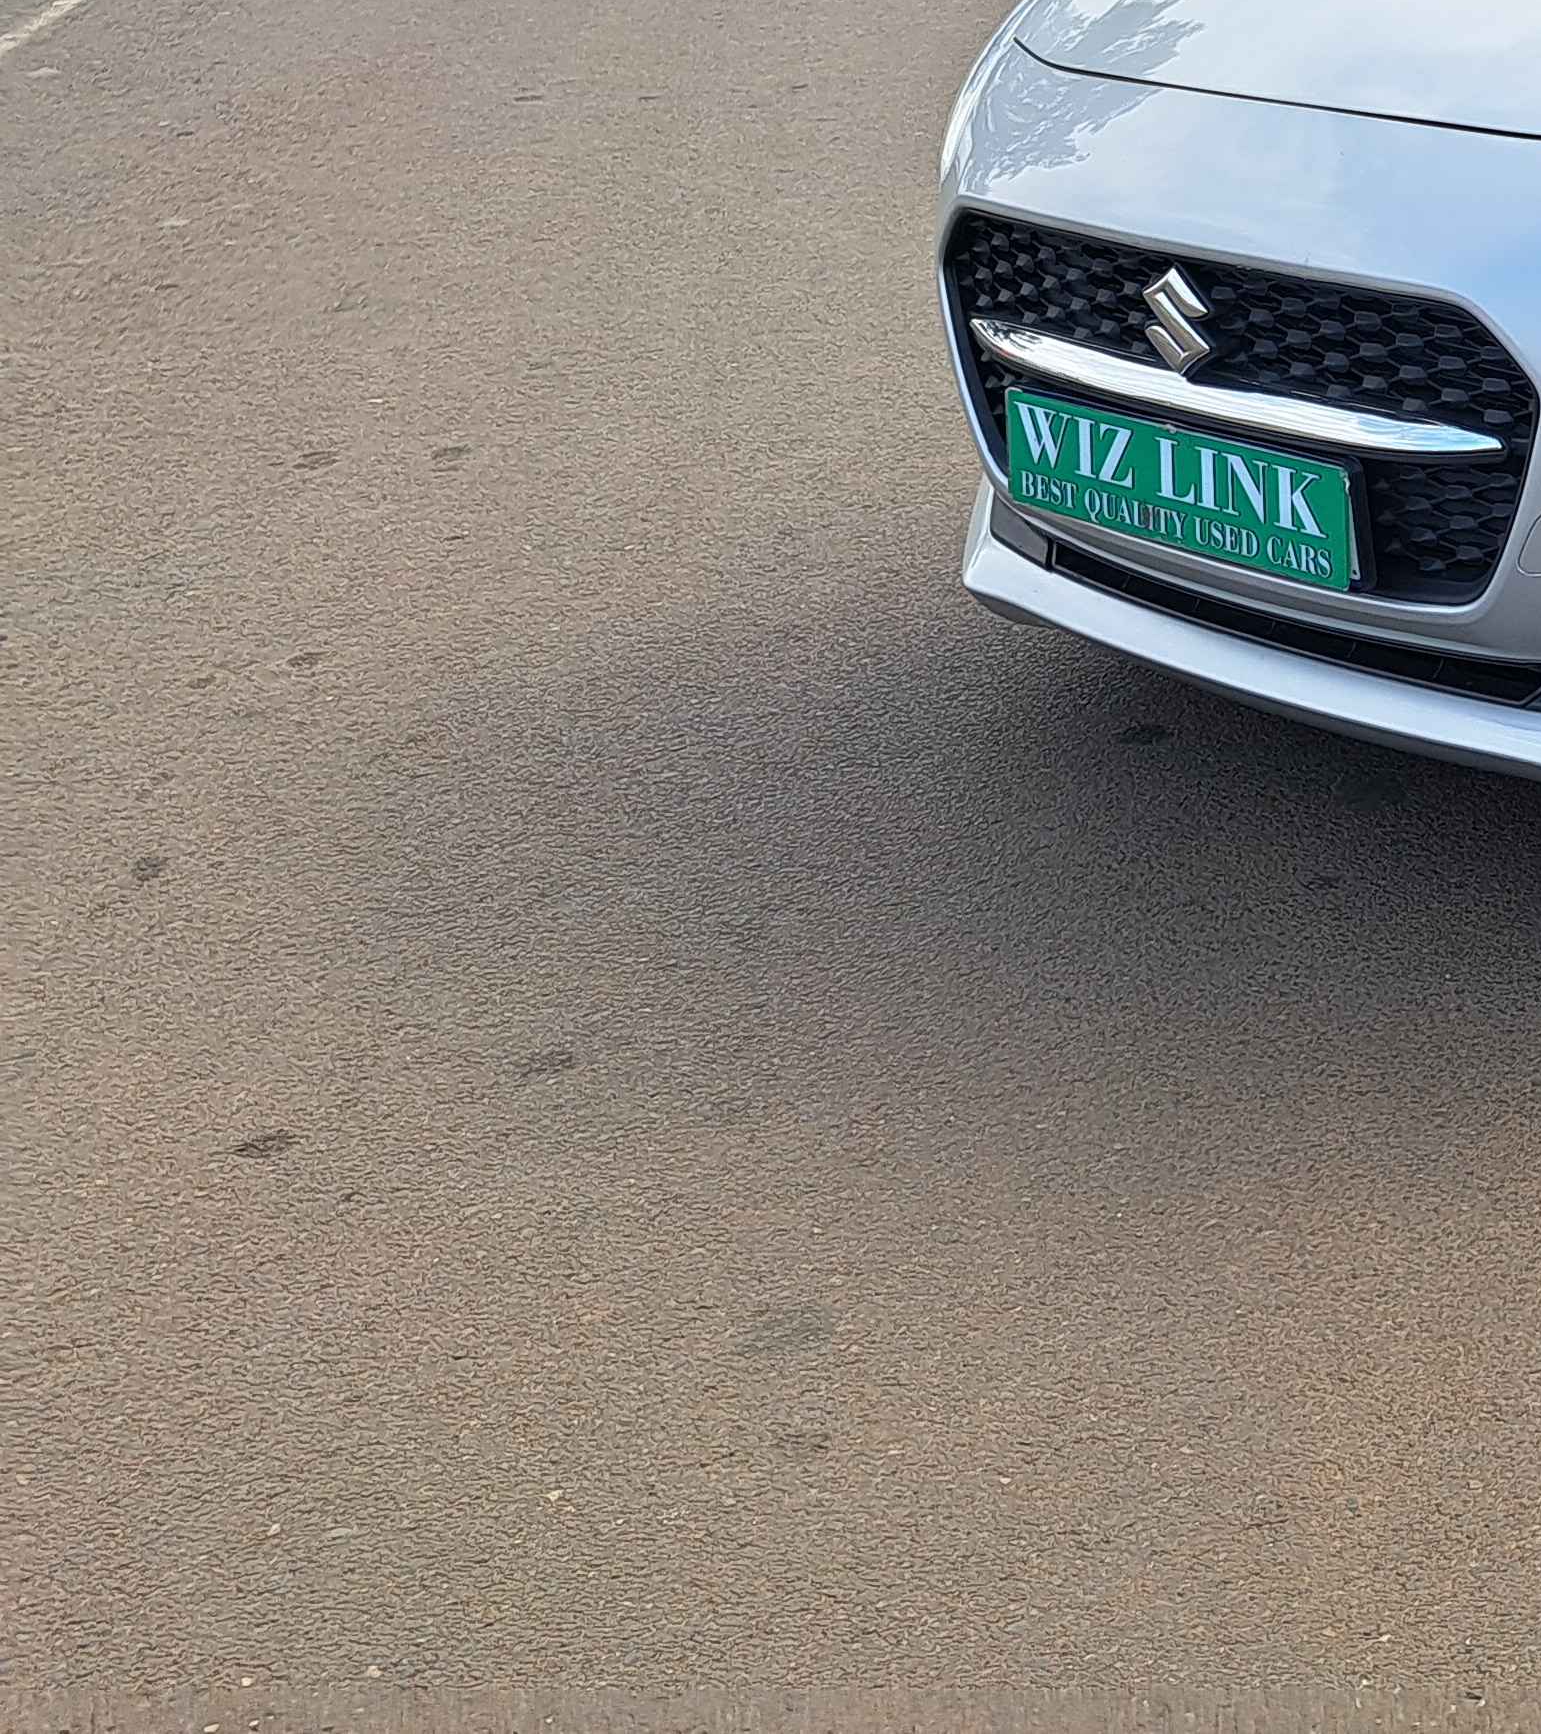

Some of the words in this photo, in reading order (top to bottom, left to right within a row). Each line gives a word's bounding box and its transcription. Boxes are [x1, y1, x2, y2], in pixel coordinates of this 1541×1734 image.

[1013, 400, 1134, 489] WIZ
[1154, 436, 1328, 539] LINK
[1019, 470, 1078, 508] BEST
[1084, 488, 1188, 544] QUALITY
[1194, 516, 1260, 558] USED
[1266, 535, 1334, 579] CARS
